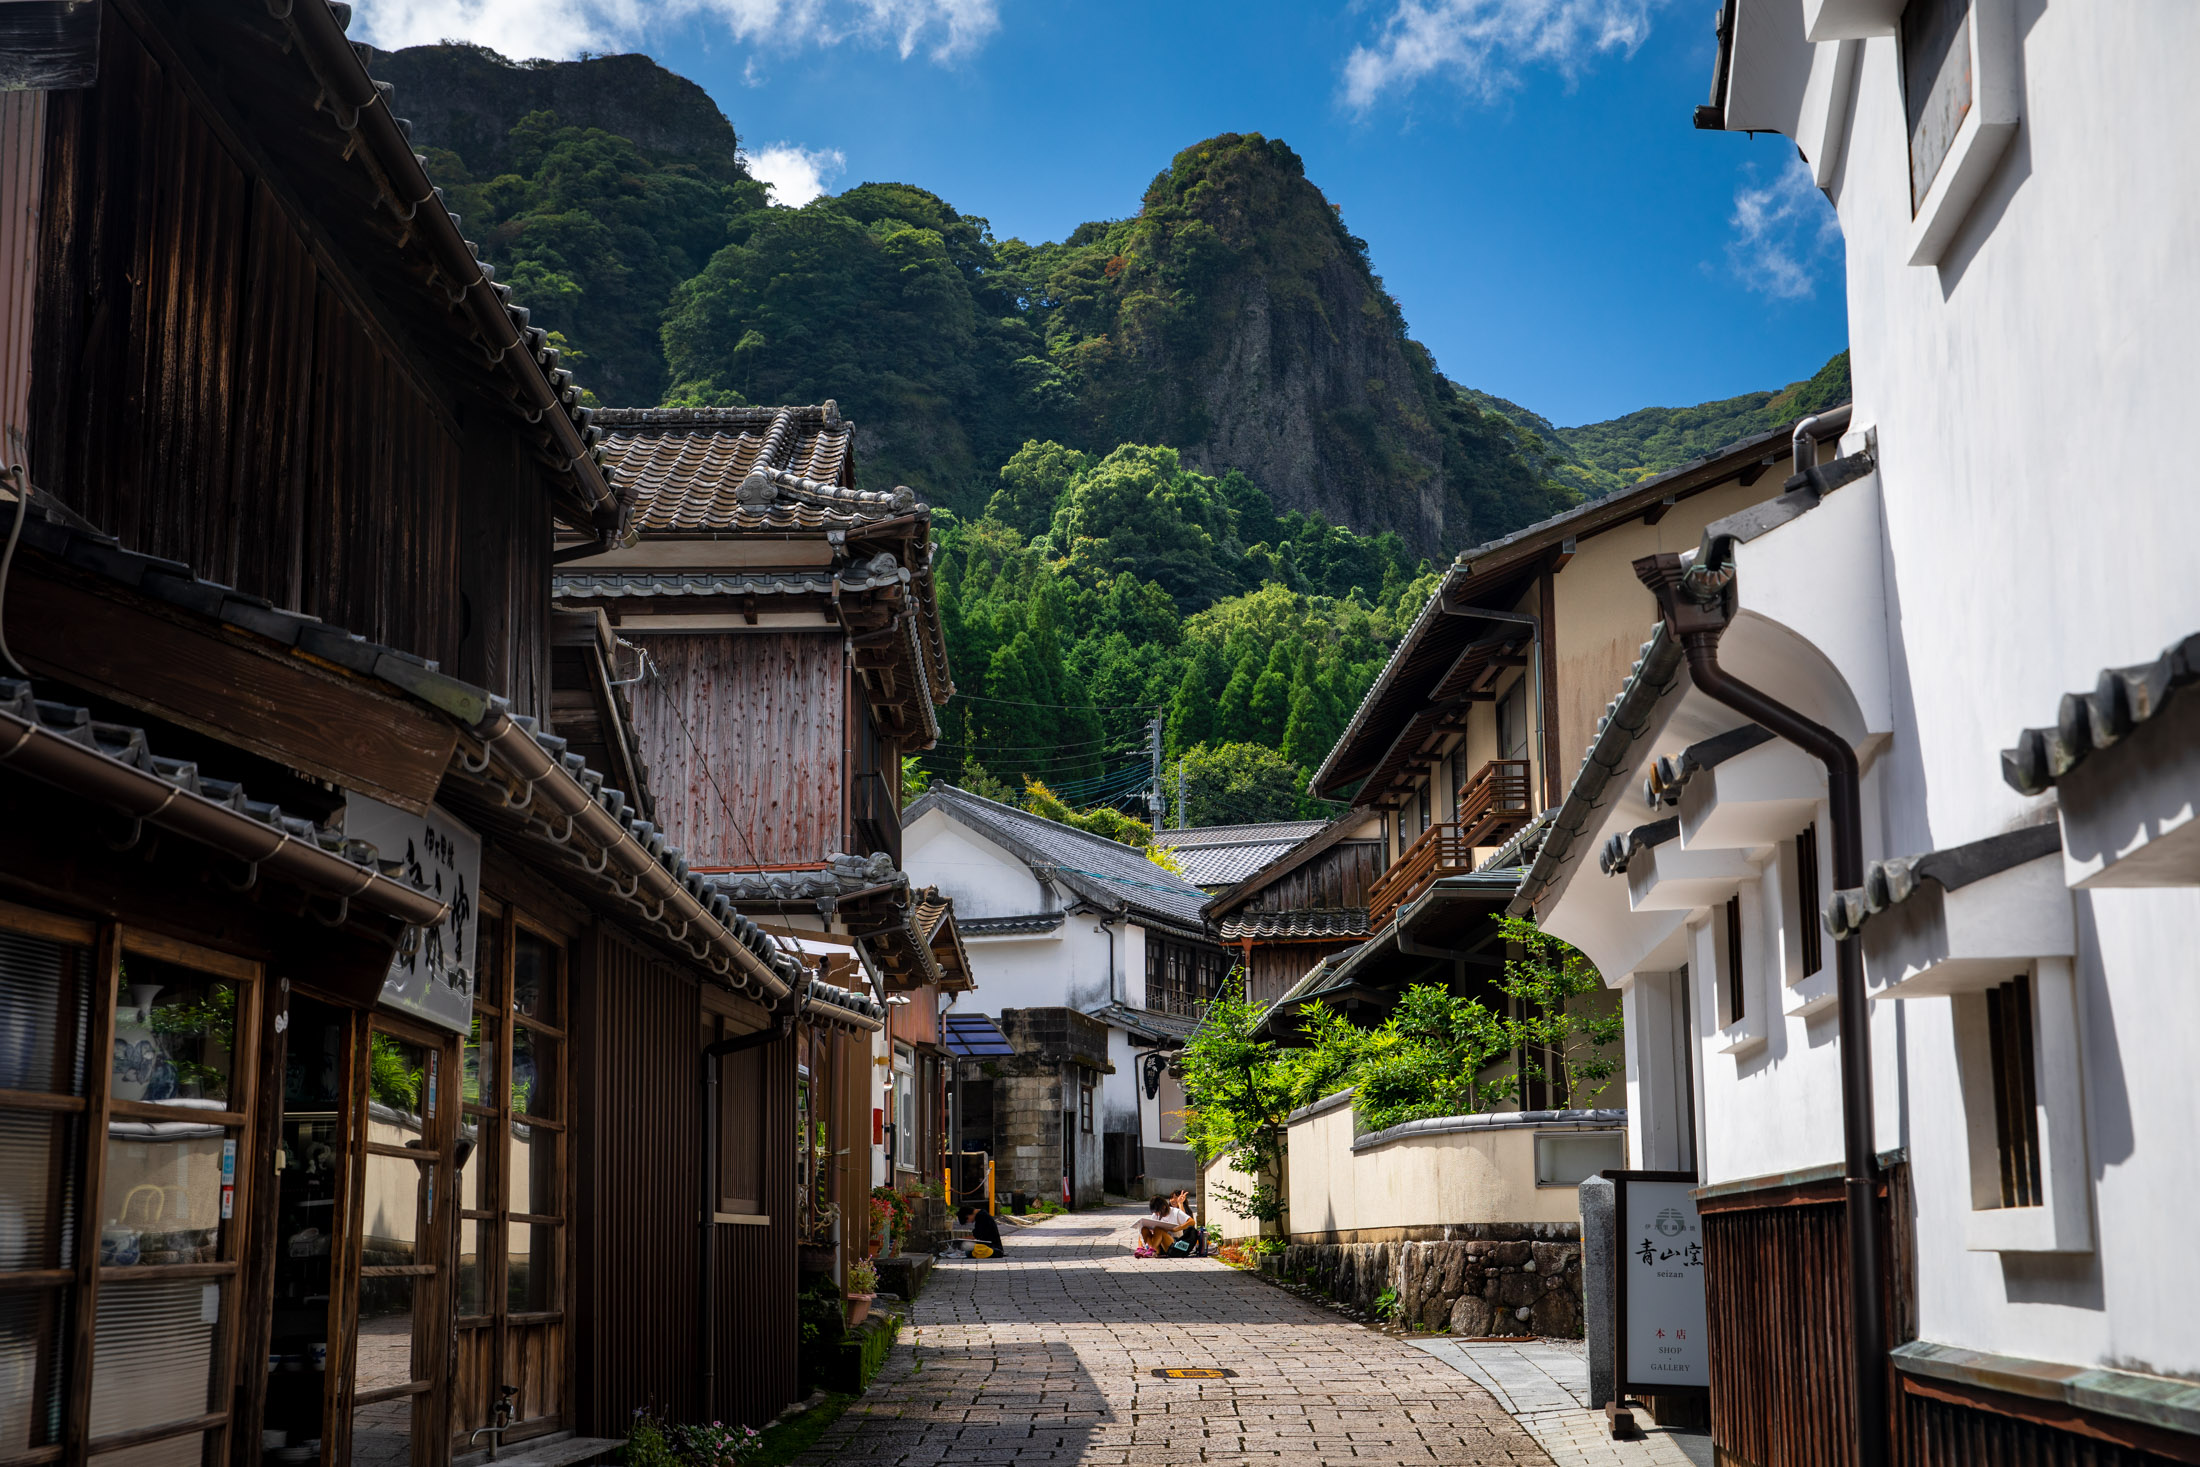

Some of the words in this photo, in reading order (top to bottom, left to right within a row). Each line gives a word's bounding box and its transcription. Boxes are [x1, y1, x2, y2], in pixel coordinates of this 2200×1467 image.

[1656, 1270, 1684, 1278] seizan
[1655, 1328, 1687, 1340] 本店
[1658, 1346, 1682, 1354] SHOP
[1650, 1363, 1690, 1372] GALLERY
